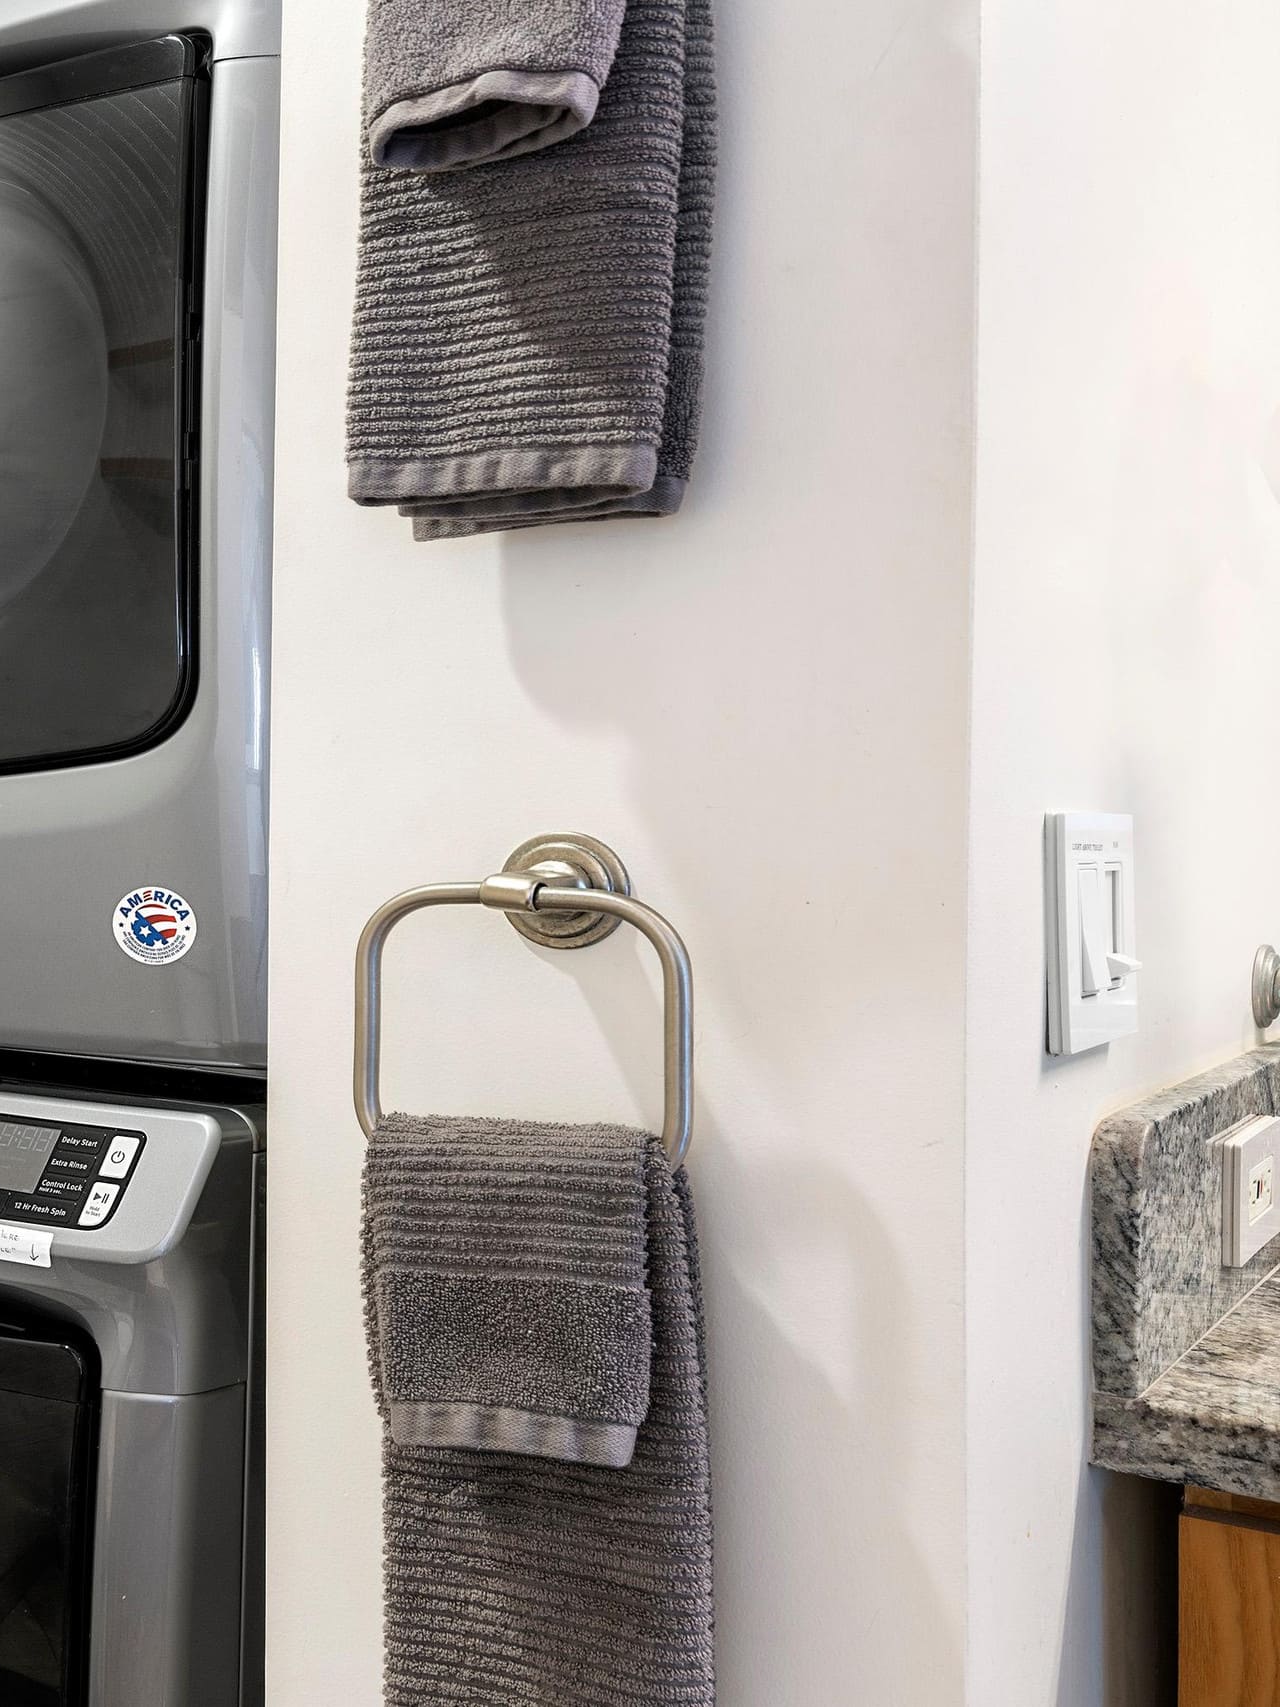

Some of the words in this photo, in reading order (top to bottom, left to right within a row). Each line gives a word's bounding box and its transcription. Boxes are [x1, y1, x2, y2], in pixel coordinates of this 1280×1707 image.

[119, 890, 190, 922] AMERICA
[62, 1136, 80, 1146] Delay
[80, 1139, 99, 1148] Start
[50, 1158, 68, 1167] Extra
[68, 1161, 88, 1171] Rinse
[41, 1179, 67, 1189] Control
[66, 1182, 83, 1192] Lock
[14, 1202, 23, 1210] 12
[22, 1204, 32, 1212] Hr
[31, 1204, 51, 1214] Fresh
[50, 1207, 67, 1218] Spin
